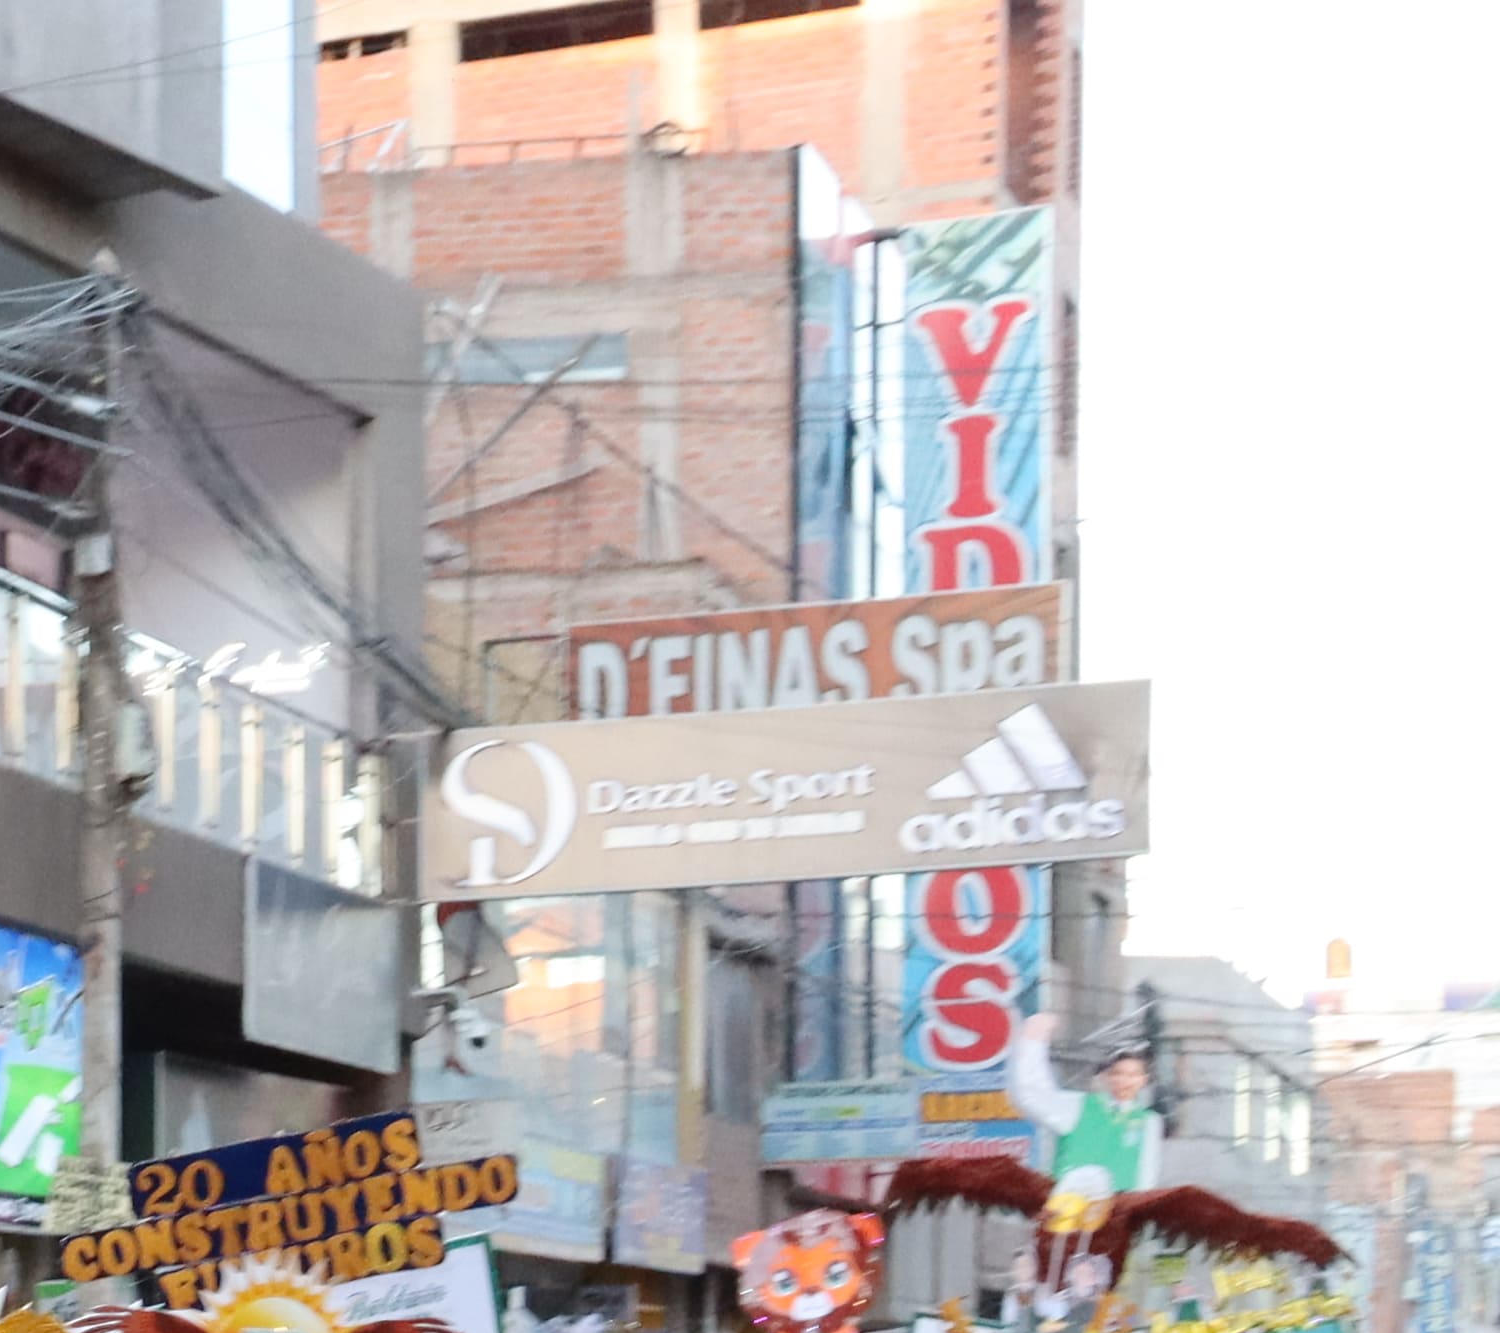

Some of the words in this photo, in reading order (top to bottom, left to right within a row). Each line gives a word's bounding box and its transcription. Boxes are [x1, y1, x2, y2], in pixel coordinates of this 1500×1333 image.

[891, 614, 1046, 698] Spa
[586, 773, 738, 815] Dazzle
[746, 764, 877, 813] Sport
[901, 793, 1126, 855] adidas
[133, 1159, 225, 1217] 20
[265, 1117, 421, 1196] AÑOS
[62, 1154, 519, 1283] CONSTRUYENDO
